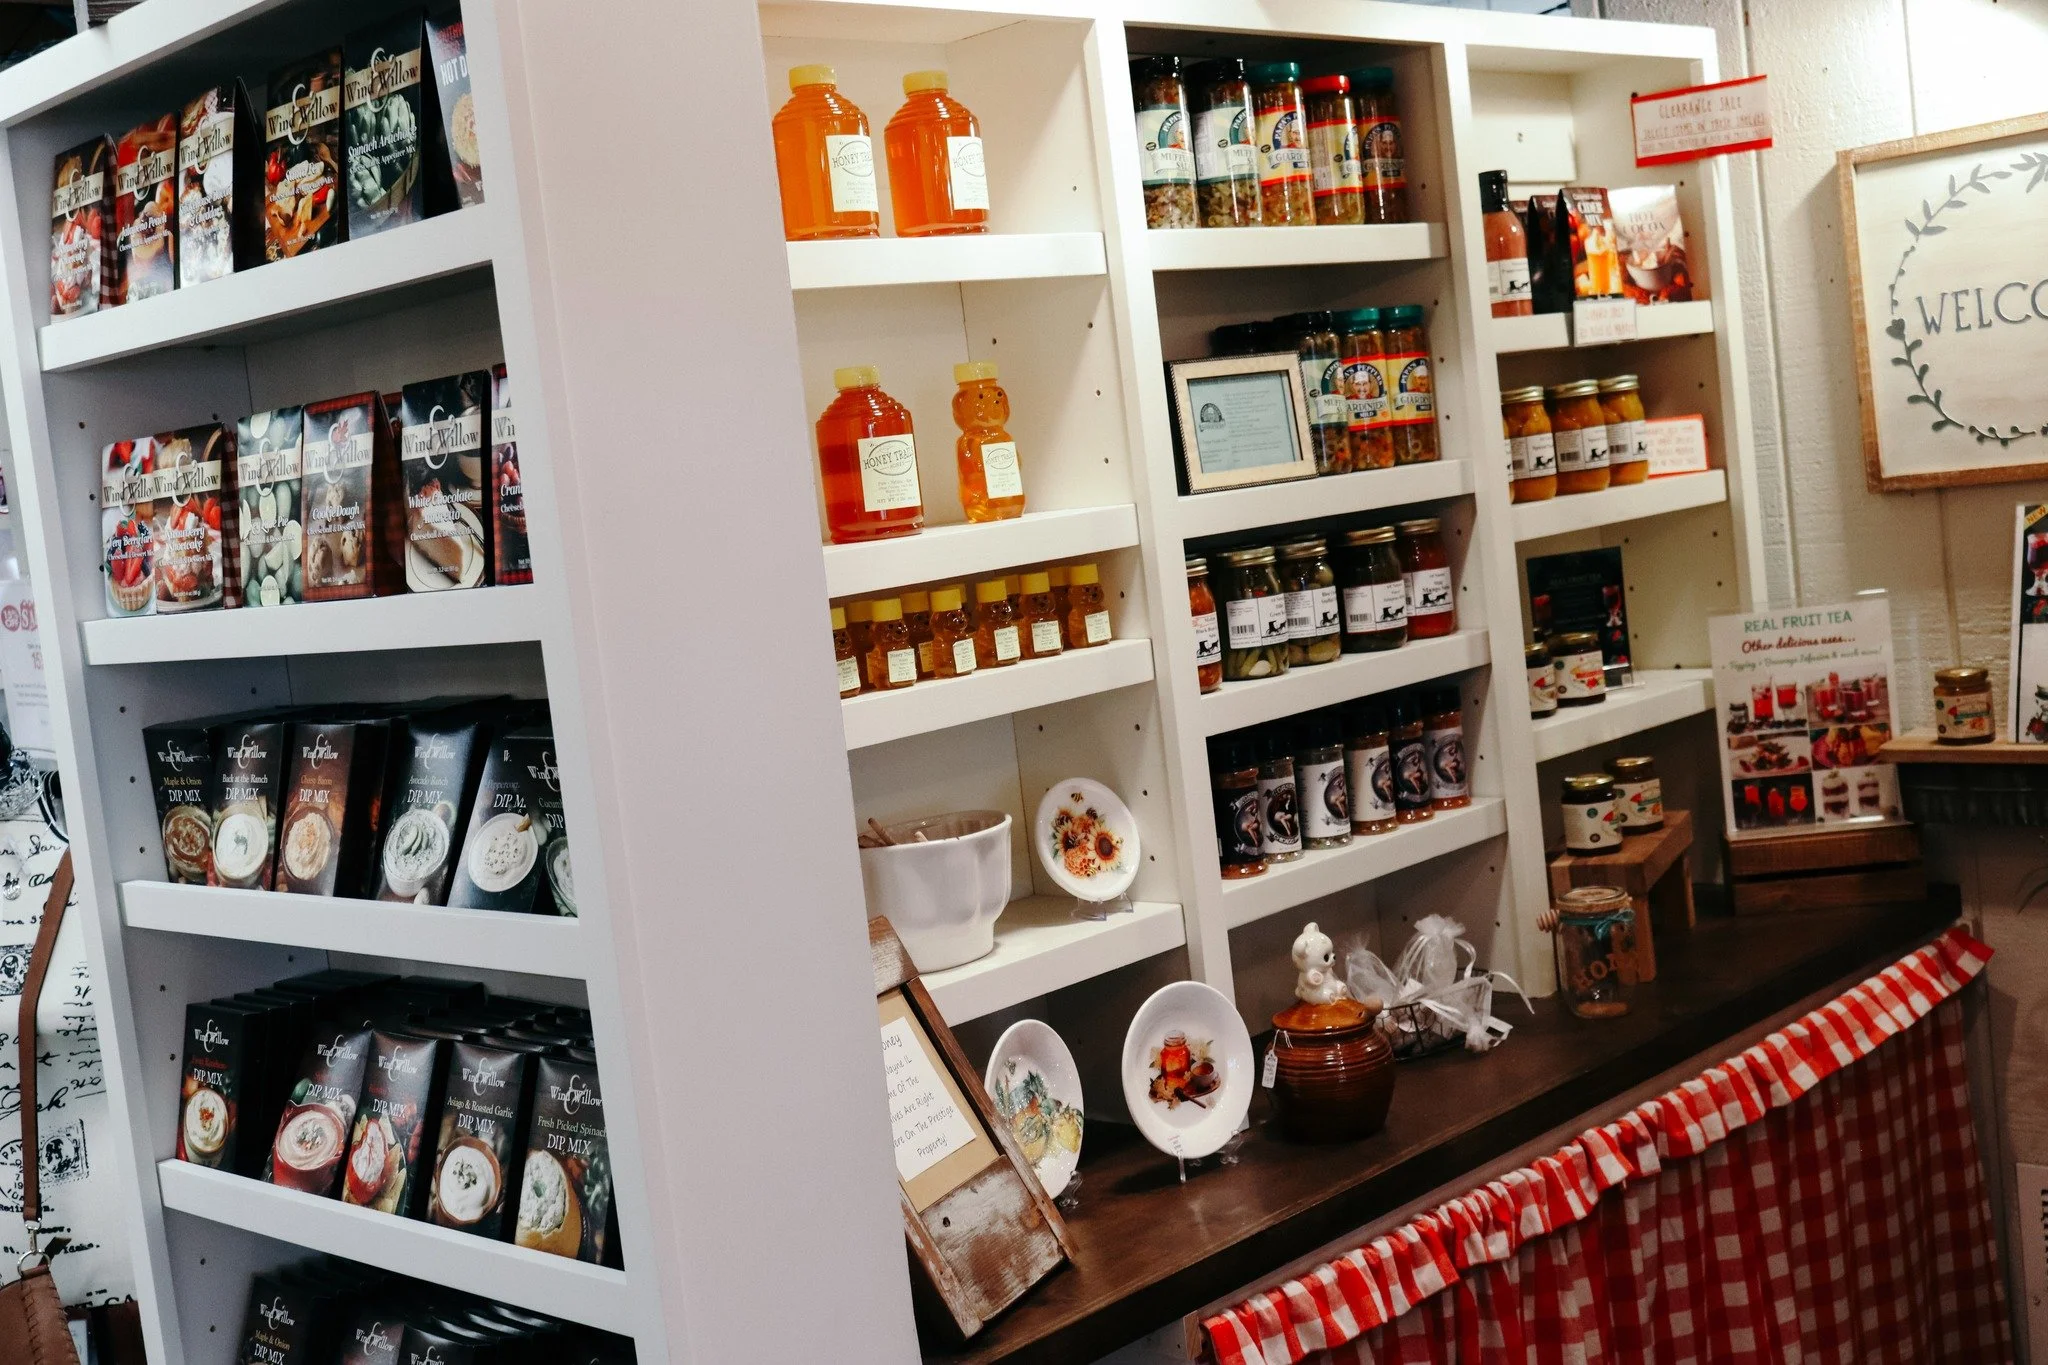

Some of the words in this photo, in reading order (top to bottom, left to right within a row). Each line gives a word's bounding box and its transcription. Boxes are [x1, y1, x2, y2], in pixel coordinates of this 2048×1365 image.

[1659, 99, 1712, 119] CLEARANCE
[1719, 96, 1742, 111] SALE
[348, 139, 378, 163] Spinach
[832, 152, 859, 169] HONEY
[1357, 364, 1384, 386] PEPPERS
[404, 427, 433, 454] Wind
[437, 422, 479, 450] Willow
[863, 451, 893, 470] HONEY
[408, 495, 431, 509] White
[431, 490, 473, 506] Chocolate
[313, 506, 335, 521] Cookie
[336, 502, 360, 520] Dough
[2027, 506, 2047, 523] NEW
[278, 517, 289, 528] Pie
[1744, 618, 1778, 633] REAL
[1783, 613, 1823, 628] FRUIT
[1827, 610, 1853, 623] TEA
[1741, 639, 1773, 654] Other
[1776, 634, 1819, 650] delicious
[227, 746, 245, 759] Wind
[243, 745, 267, 759] Willow
[302, 746, 318, 759] Wind
[317, 745, 339, 760] Willow
[414, 747, 431, 759] Wind
[432, 744, 456, 760] Willow
[164, 776, 179, 786] Maple
[180, 777, 185, 785] &
[186, 777, 202, 786] Onion
[222, 774, 234, 783] Back
[234, 775, 240, 783] at
[240, 774, 249, 783] the
[250, 774, 268, 784] Ranch
[408, 776, 429, 786] Avocado
[430, 776, 448, 786] Ranch
[168, 789, 183, 802] DIP
[184, 789, 201, 802] MIX
[225, 787, 240, 800] DIP
[241, 788, 259, 800] MIX
[300, 789, 313, 802] DIP
[314, 790, 330, 803] MIX
[407, 789, 424, 803] DIP
[424, 790, 444, 803] MIX
[494, 794, 513, 808] DIP
[546, 814, 564, 828] DIP
[194, 1028, 208, 1042] Wind
[209, 1028, 229, 1046] Willow
[317, 1044, 333, 1057] Wind
[334, 1045, 360, 1061] Willow
[904, 1055, 912, 1065] IL
[378, 1055, 394, 1069] Wind
[398, 1056, 418, 1075] Willow
[193, 1068, 207, 1082] DIP
[207, 1071, 223, 1086] MIX
[462, 1067, 479, 1084] Wind
[480, 1071, 506, 1089] Willow
[897, 1082, 906, 1094] Of
[905, 1076, 919, 1087] The
[306, 1083, 322, 1097] DIP
[324, 1086, 343, 1100] MIX
[550, 1085, 571, 1101] Wind
[573, 1087, 603, 1107] Willow
[373, 1098, 388, 1113] DIP
[389, 1101, 407, 1118] MIX
[447, 1096, 464, 1110] Asiago
[465, 1101, 471, 1110] &
[471, 1102, 494, 1116] Roasted
[495, 1105, 514, 1119] Garlic
[904, 1102, 916, 1116] Are
[916, 1092, 935, 1107] Right
[457, 1113, 474, 1130] DIP
[476, 1118, 495, 1135] MIX
[537, 1116, 555, 1130] Fresh
[556, 1119, 579, 1134] Picked
[580, 1123, 607, 1138] Spinach
[905, 1129, 915, 1140] On
[915, 1121, 928, 1136] The
[928, 1105, 954, 1125] Prestige
[547, 1134, 565, 1151] DIP
[567, 1139, 591, 1156] MIX
[917, 1133, 948, 1157] Property!
[260, 1303, 274, 1319] Wind
[274, 1308, 295, 1327] Willow
[254, 1343, 268, 1359] DIP
[268, 1348, 285, 1365] MIX
